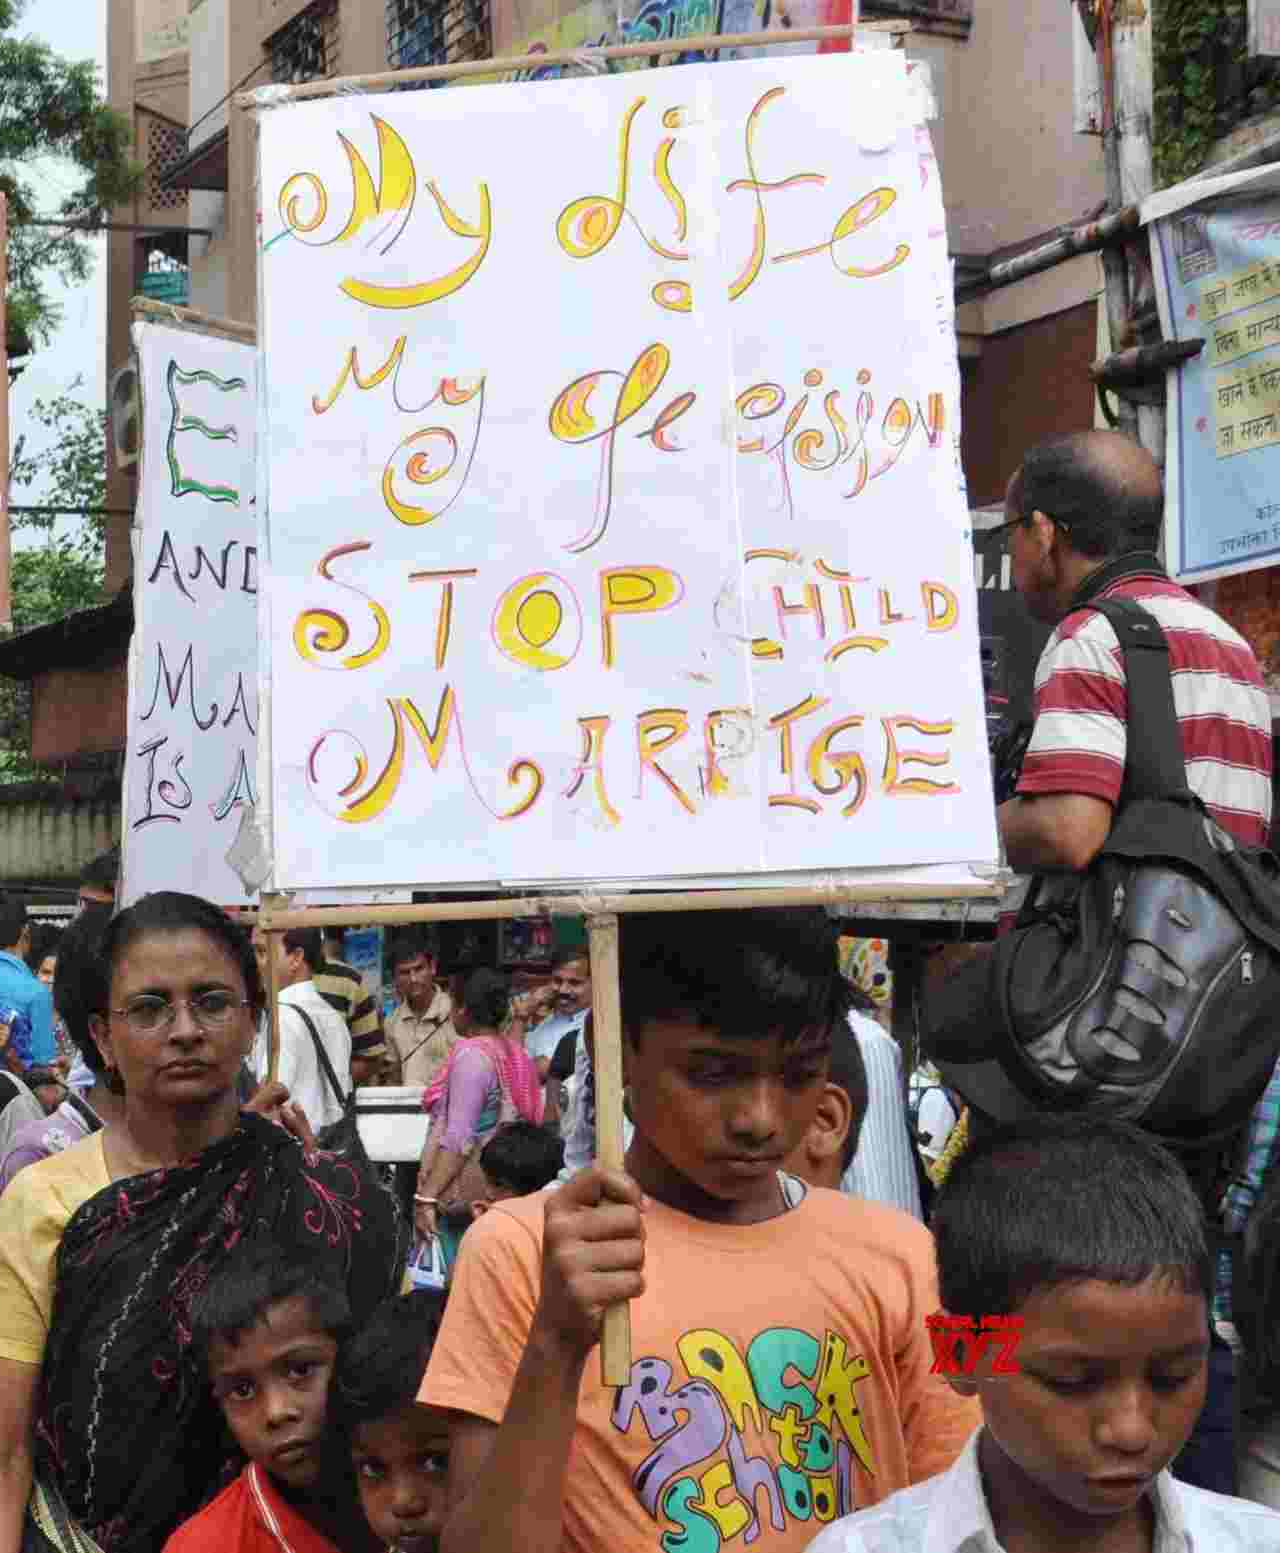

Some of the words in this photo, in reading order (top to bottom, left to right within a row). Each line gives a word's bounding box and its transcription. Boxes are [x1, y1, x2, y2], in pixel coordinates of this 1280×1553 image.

[263, 112, 491, 309] My
[312, 336, 486, 525] My
[292, 541, 685, 670] STOP
[714, 548, 961, 664] CHILD
[132, 736, 193, 829] IS
